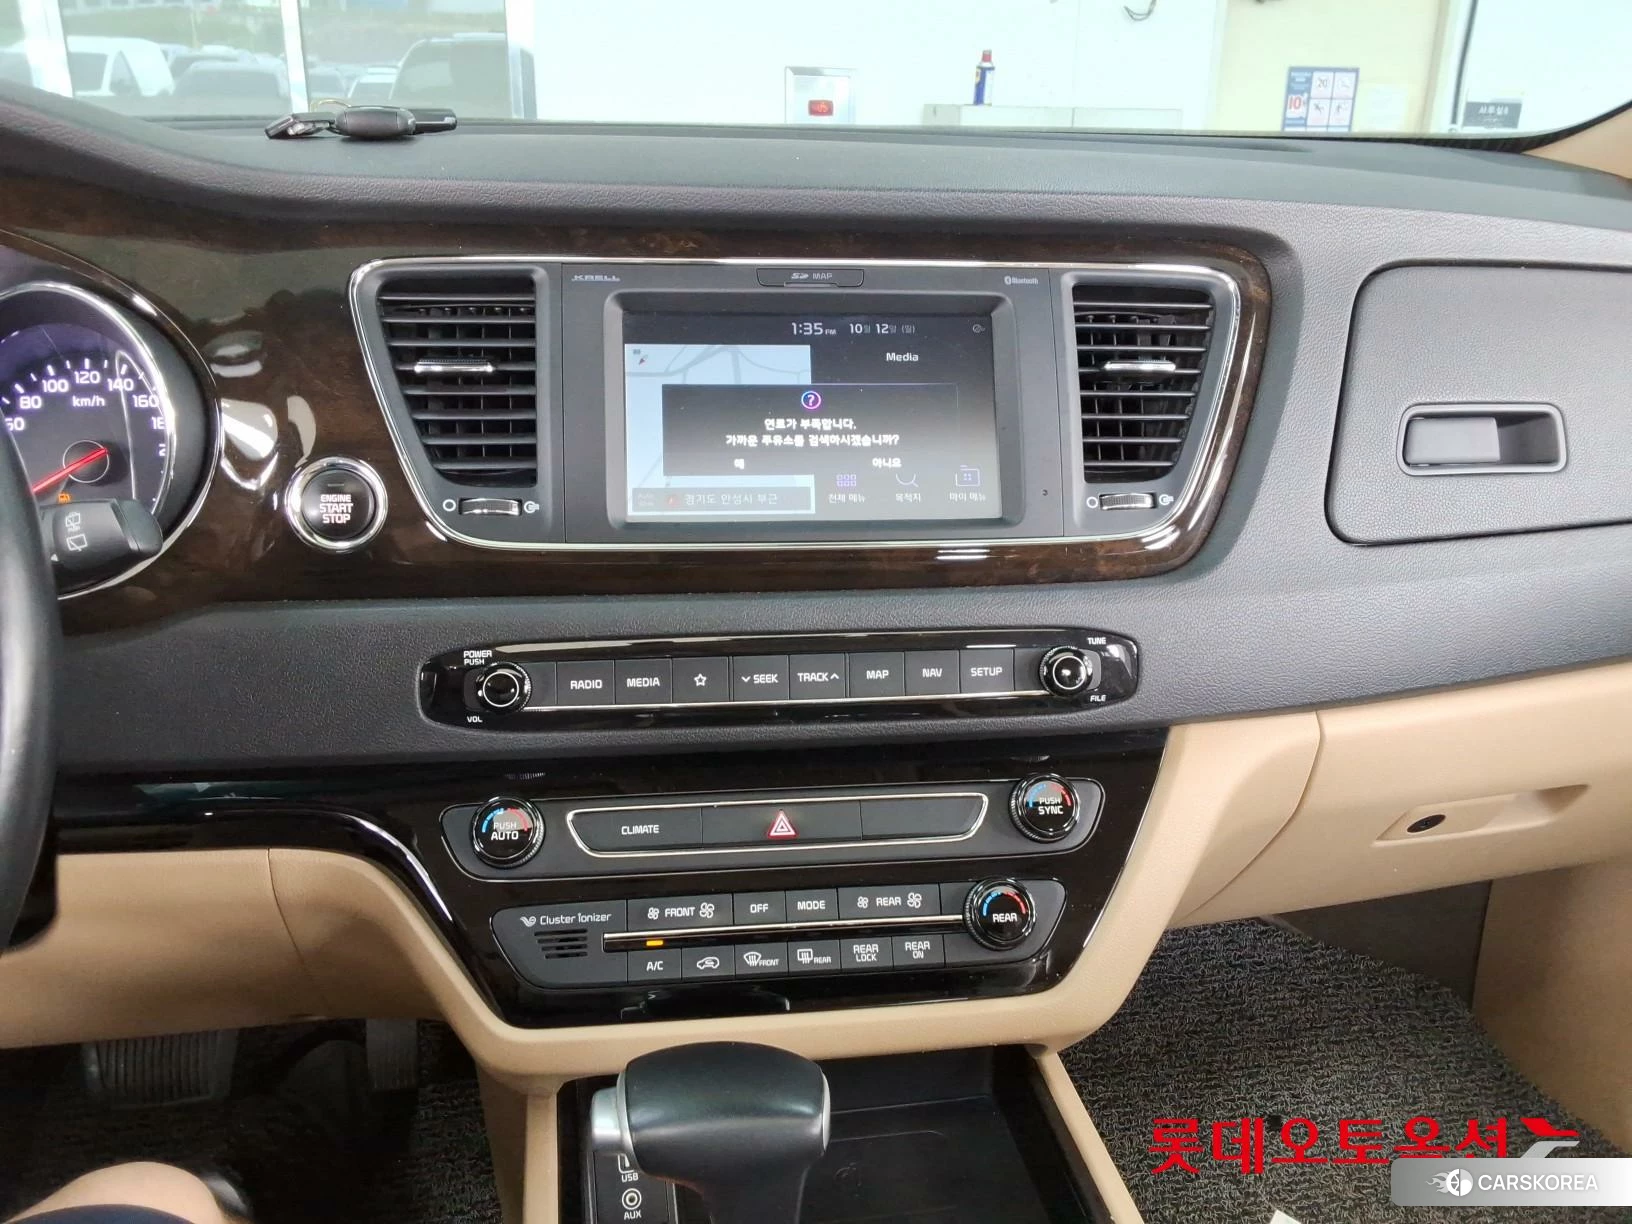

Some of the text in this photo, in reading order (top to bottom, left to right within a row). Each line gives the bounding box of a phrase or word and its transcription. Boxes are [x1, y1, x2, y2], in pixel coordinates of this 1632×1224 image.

[812, 272, 833, 280] MAP
[791, 322, 823, 335] 1:35
[886, 352, 919, 362] Media
[74, 371, 100, 384] 120
[42, 379, 69, 393] 100
[108, 379, 134, 392] 140
[20, 396, 42, 409] 80
[72, 395, 105, 407] km/h
[132, 395, 159, 408] 160
[764, 418, 857, 431] 연료가 부족합니다.
[725, 434, 900, 447] 가까운 주유소를 검색하시겠습니까?
[871, 457, 902, 469] 아니요
[320, 493, 352, 503] ENGINE
[684, 493, 777, 505] 경기도 안성시 부근
[828, 493, 846, 504] 전체
[895, 493, 921, 503] 목적지
[949, 492, 967, 503] 마이
[319, 502, 354, 513] START
[322, 513, 351, 524] STOP
[1087, 636, 1107, 646] TUNE
[463, 650, 493, 659] POWER
[463, 658, 485, 666] PUSH
[797, 671, 829, 683] TRACK
[865, 669, 890, 680] MAP
[922, 667, 943, 678] NAV
[970, 666, 1003, 677] SETUP
[570, 679, 603, 690] RADIO
[626, 676, 661, 688] MEDIA
[753, 673, 779, 685] SEEK
[1089, 694, 1107, 704] FILE
[466, 715, 483, 724] VOL
[1038, 797, 1061, 806] PUSH
[1037, 805, 1064, 816] SYNC
[493, 821, 517, 831] PUSH
[621, 824, 660, 835] CLIMATE
[490, 830, 519, 841] AUTO
[797, 900, 826, 911] MODE
[876, 896, 902, 907] REAR
[664, 906, 696, 917] FRONT
[750, 903, 769, 914] OFF
[539, 913, 576, 925] Cluster
[992, 912, 1018, 923] REAR
[852, 943, 879, 954] REAR
[904, 940, 931, 951] REAR
[813, 955, 832, 964] REAR
[855, 952, 877, 962] LOCK
[912, 950, 925, 959] ON
[646, 960, 664, 972] A/C
[758, 957, 780, 967] FRONT
[621, 1173, 639, 1183] USB
[623, 1210, 642, 1221] AUX
